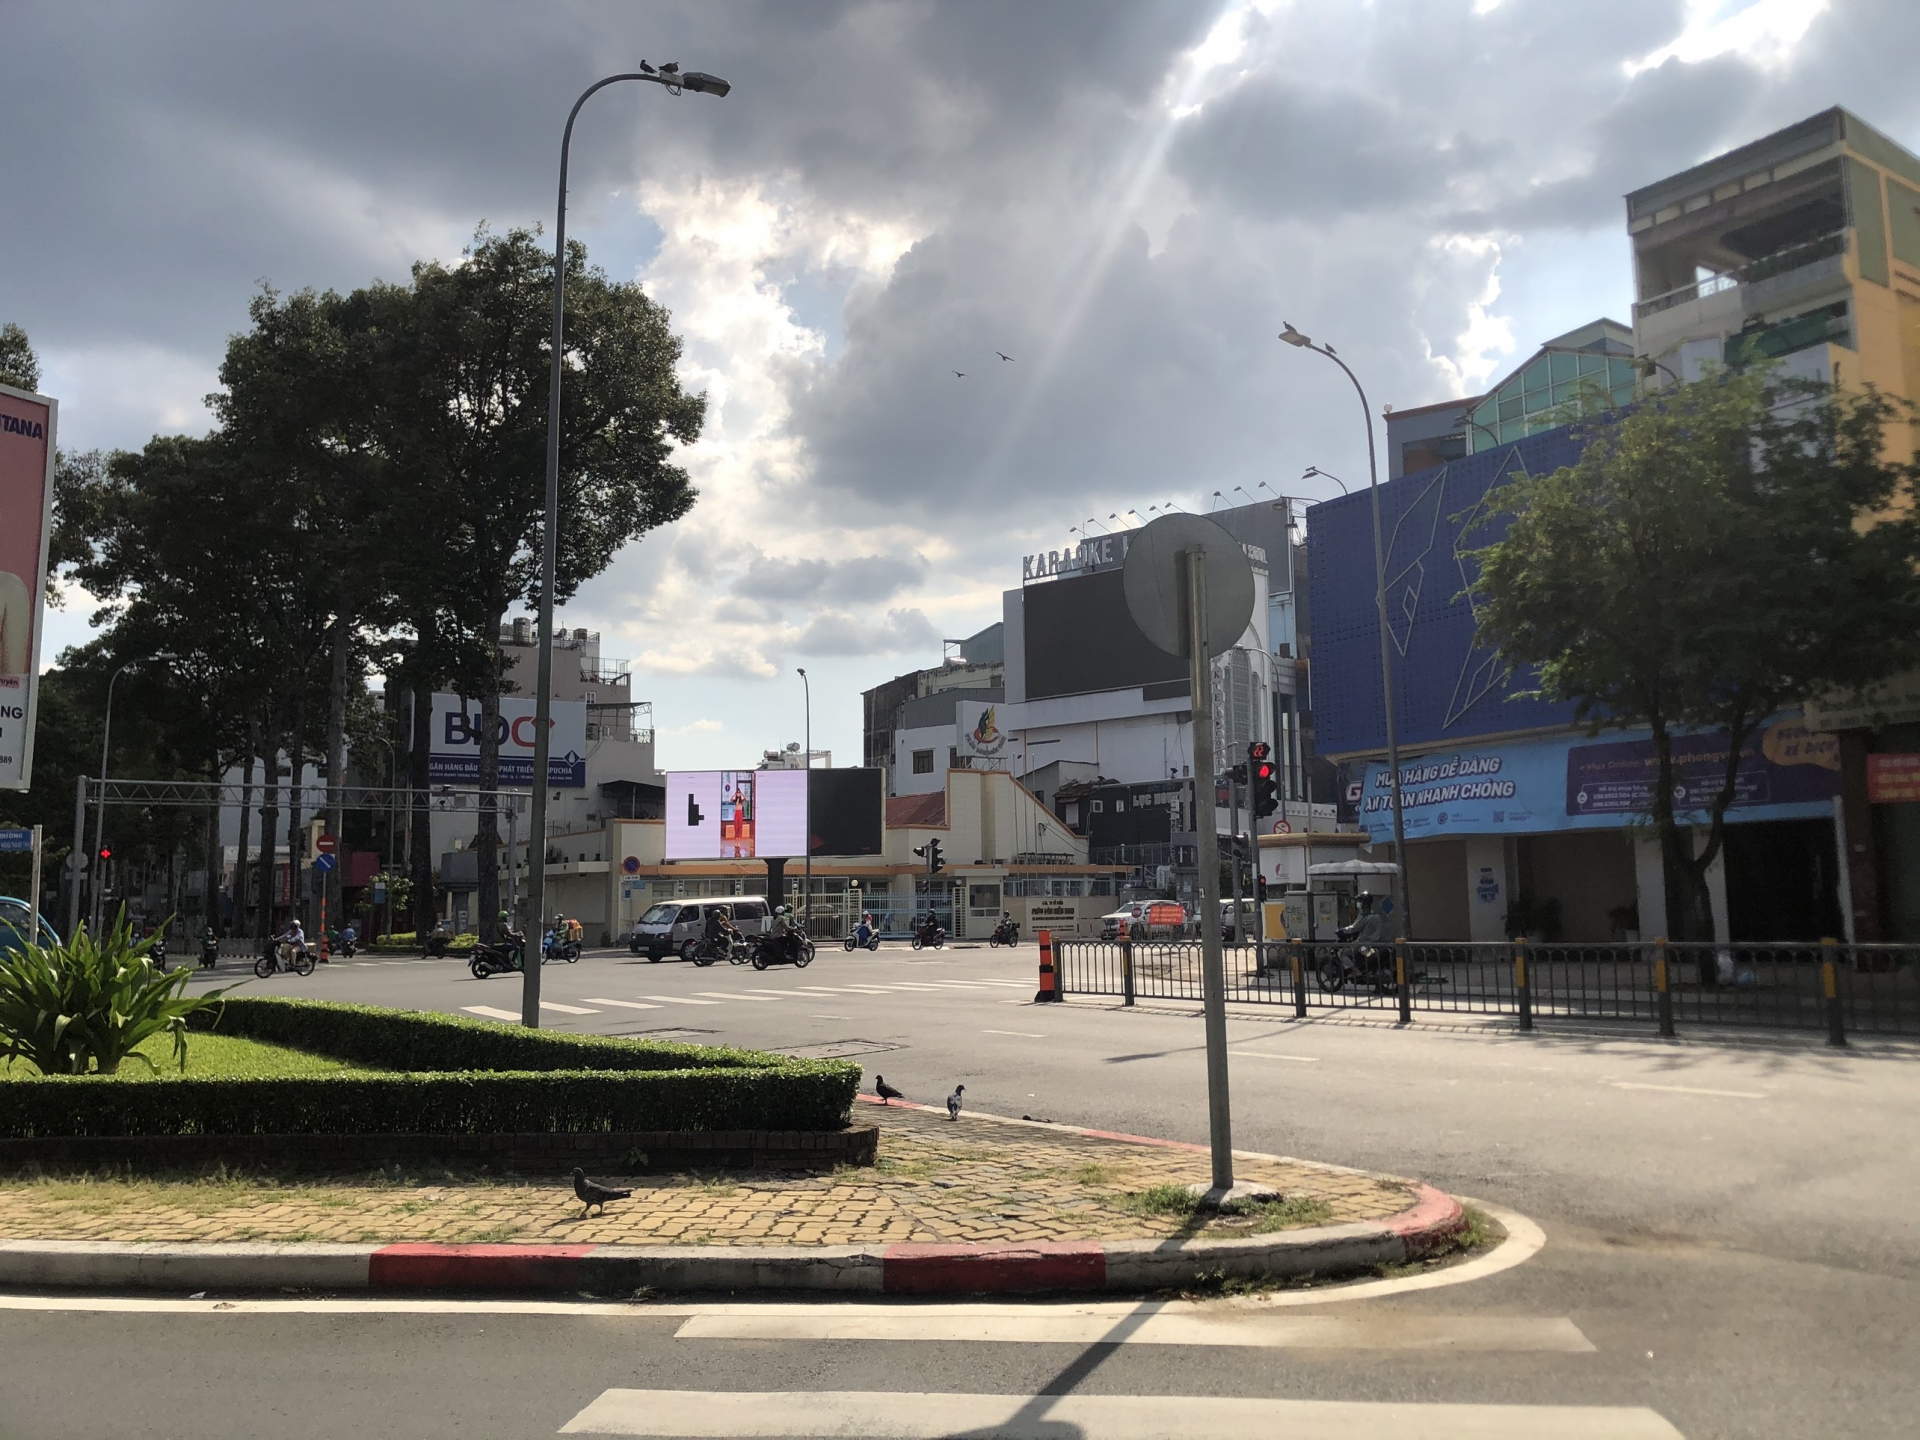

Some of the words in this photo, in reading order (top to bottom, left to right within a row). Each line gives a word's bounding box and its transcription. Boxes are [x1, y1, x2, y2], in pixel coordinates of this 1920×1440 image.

[0, 413, 43, 440] TANA
[1023, 539, 1113, 578] KARAOKE
[1253, 744, 1264, 757] 22
[429, 762, 443, 771] GÂN
[445, 762, 463, 771] HÀNG
[499, 764, 515, 774] PHÁT
[548, 766, 573, 775] PUCHIA
[1404, 765, 1439, 784] HÀNG
[1440, 755, 1459, 780] DỄ
[1459, 756, 1501, 777] DÀNG
[1364, 795, 1381, 812] AN
[1417, 784, 1460, 807] NHANH
[1460, 777, 1516, 802] CHÓNG
